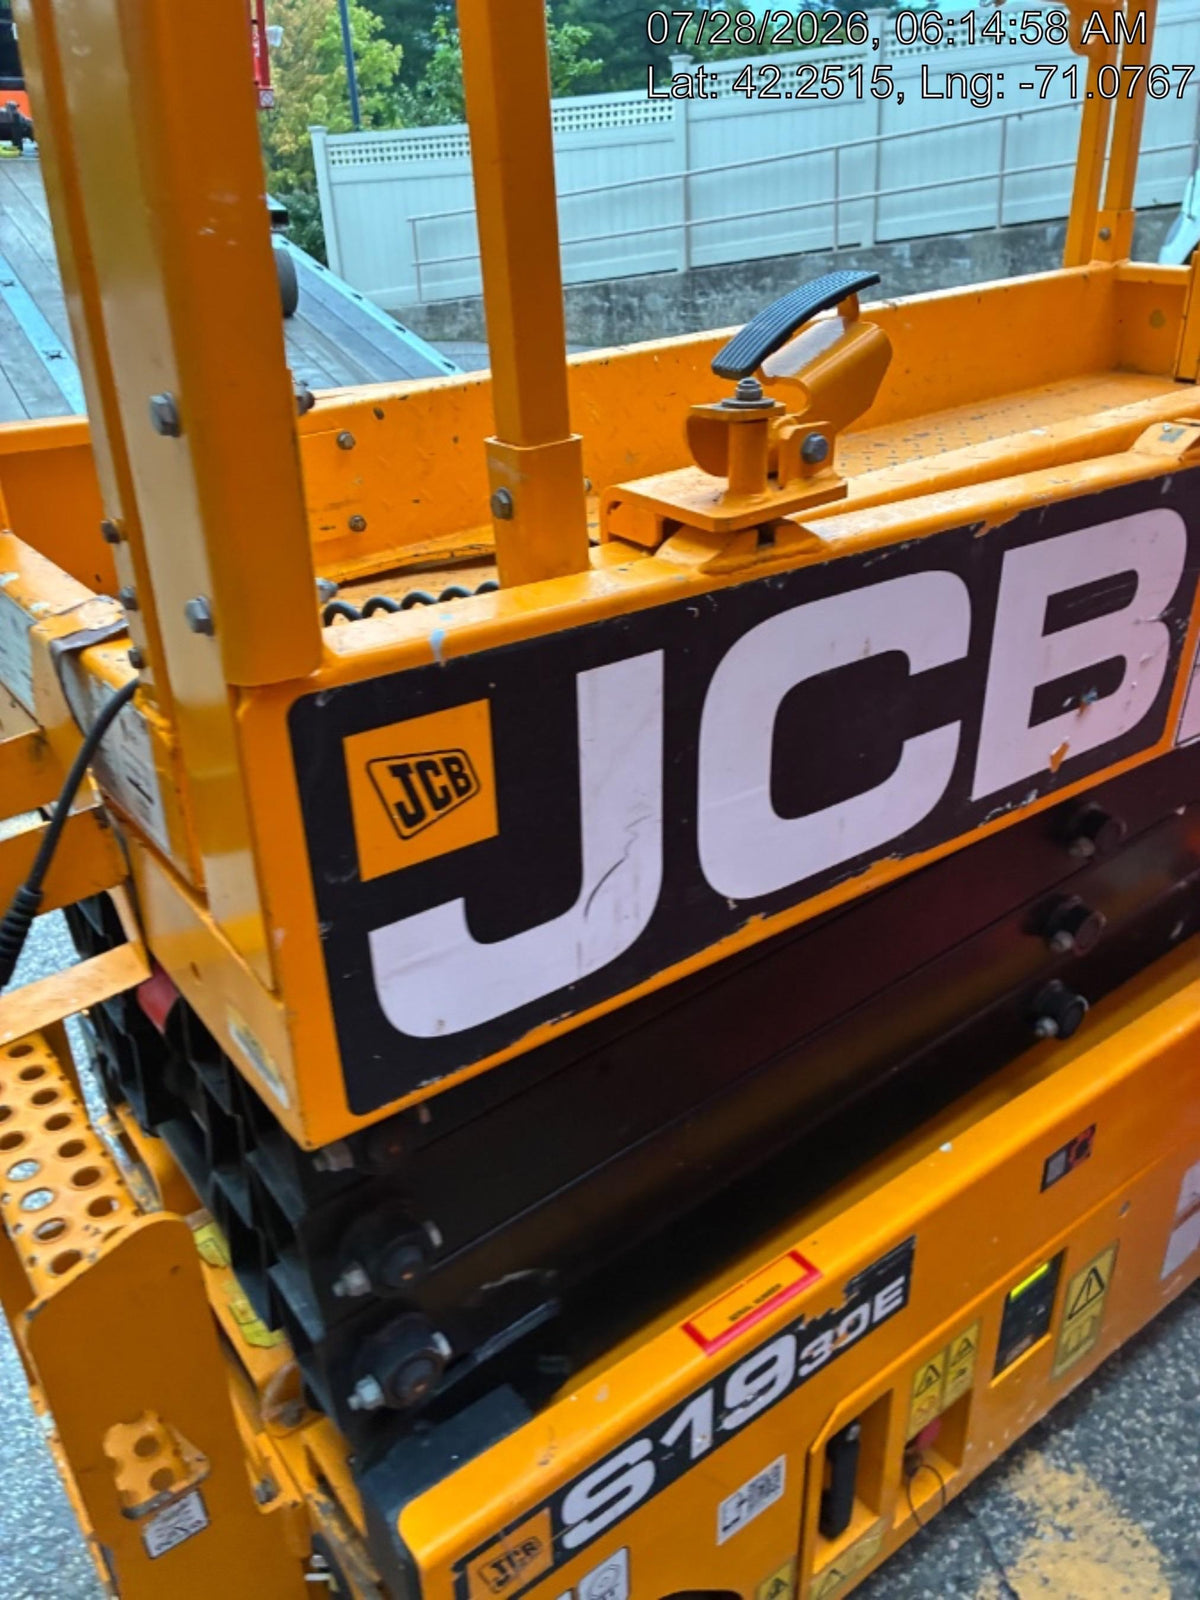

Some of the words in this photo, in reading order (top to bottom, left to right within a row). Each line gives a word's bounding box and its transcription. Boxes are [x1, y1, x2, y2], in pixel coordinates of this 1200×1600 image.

[367, 507, 1188, 1038] JCB
[388, 756, 472, 829] JCB
[562, 1276, 906, 1550] S1930E
